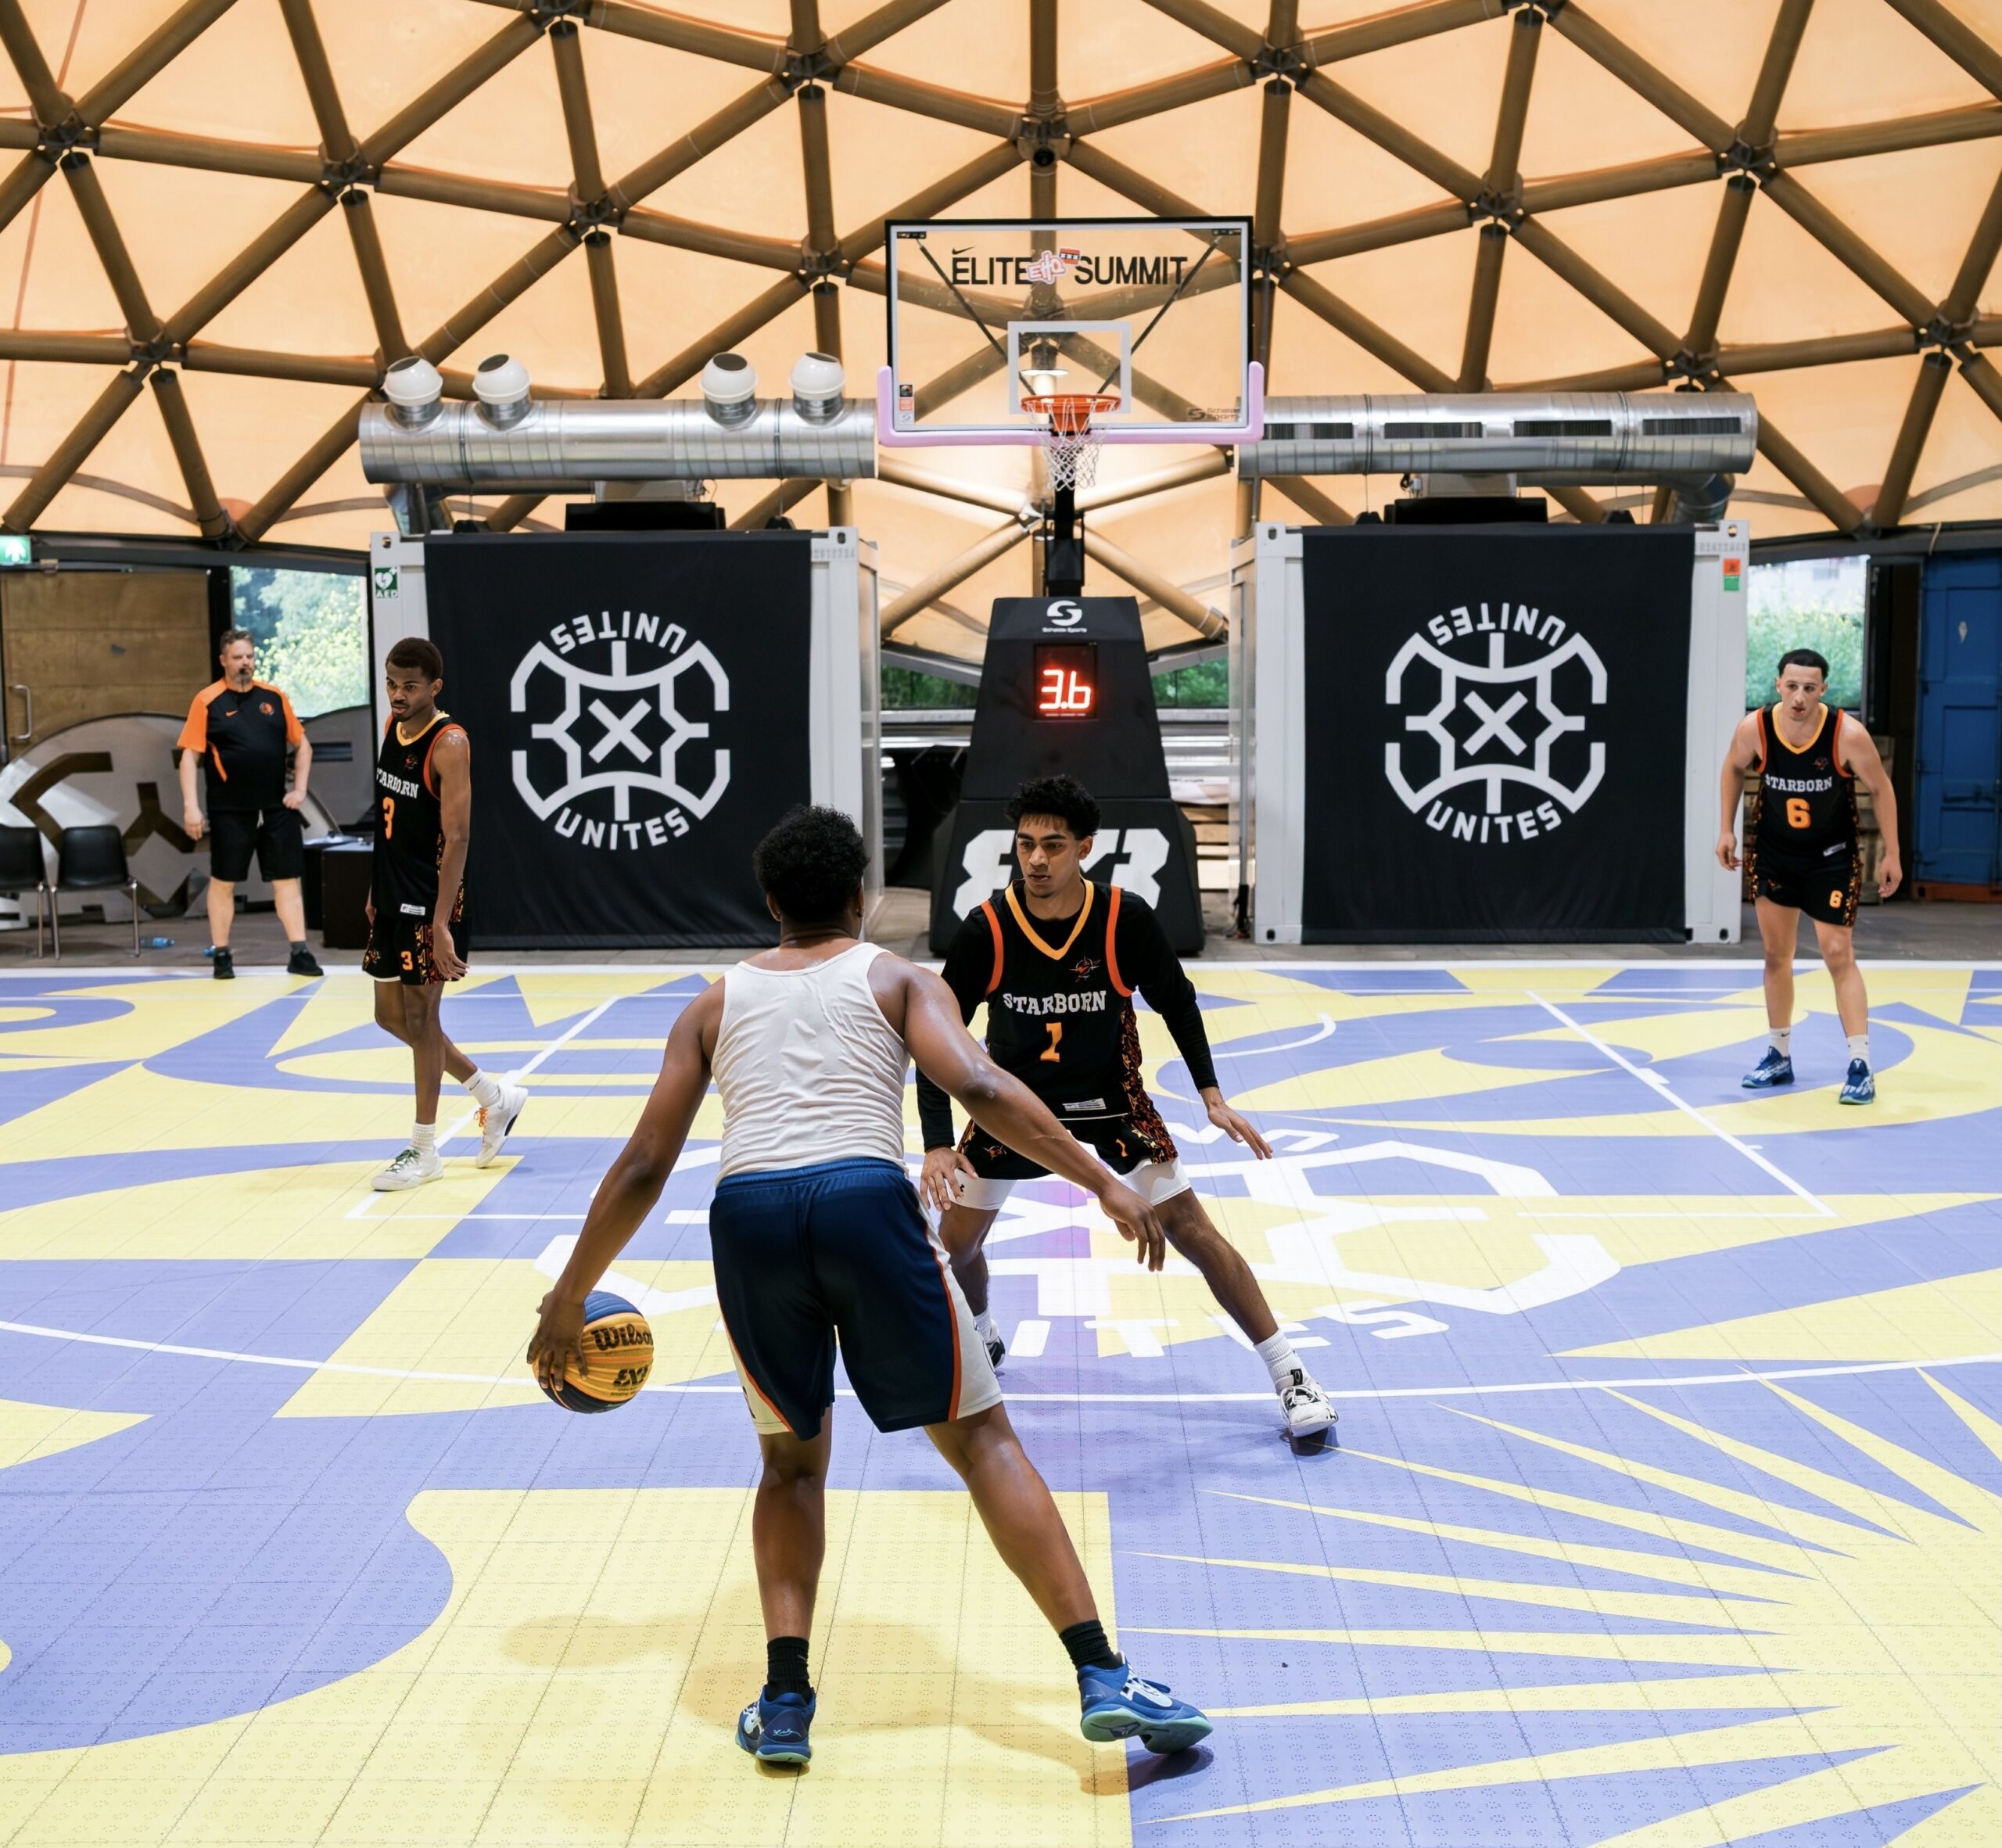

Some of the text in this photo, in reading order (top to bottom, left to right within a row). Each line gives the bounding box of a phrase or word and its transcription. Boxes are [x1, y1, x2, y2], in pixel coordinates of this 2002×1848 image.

[1075, 256, 1188, 285] SUMMIT
[550, 610, 687, 655] UNITES
[1428, 602, 1566, 648] UNITES
[1764, 773, 1833, 793] STARBORN
[382, 796, 395, 840] 3
[554, 806, 691, 851] UNITES
[1425, 799, 1562, 845] UNITES
[1786, 798, 1812, 829] 6
[1828, 889, 1843, 909] 6
[400, 950, 414, 971] 3
[1003, 989, 1107, 1016] STARBORN
[1039, 1021, 1063, 1064] 1
